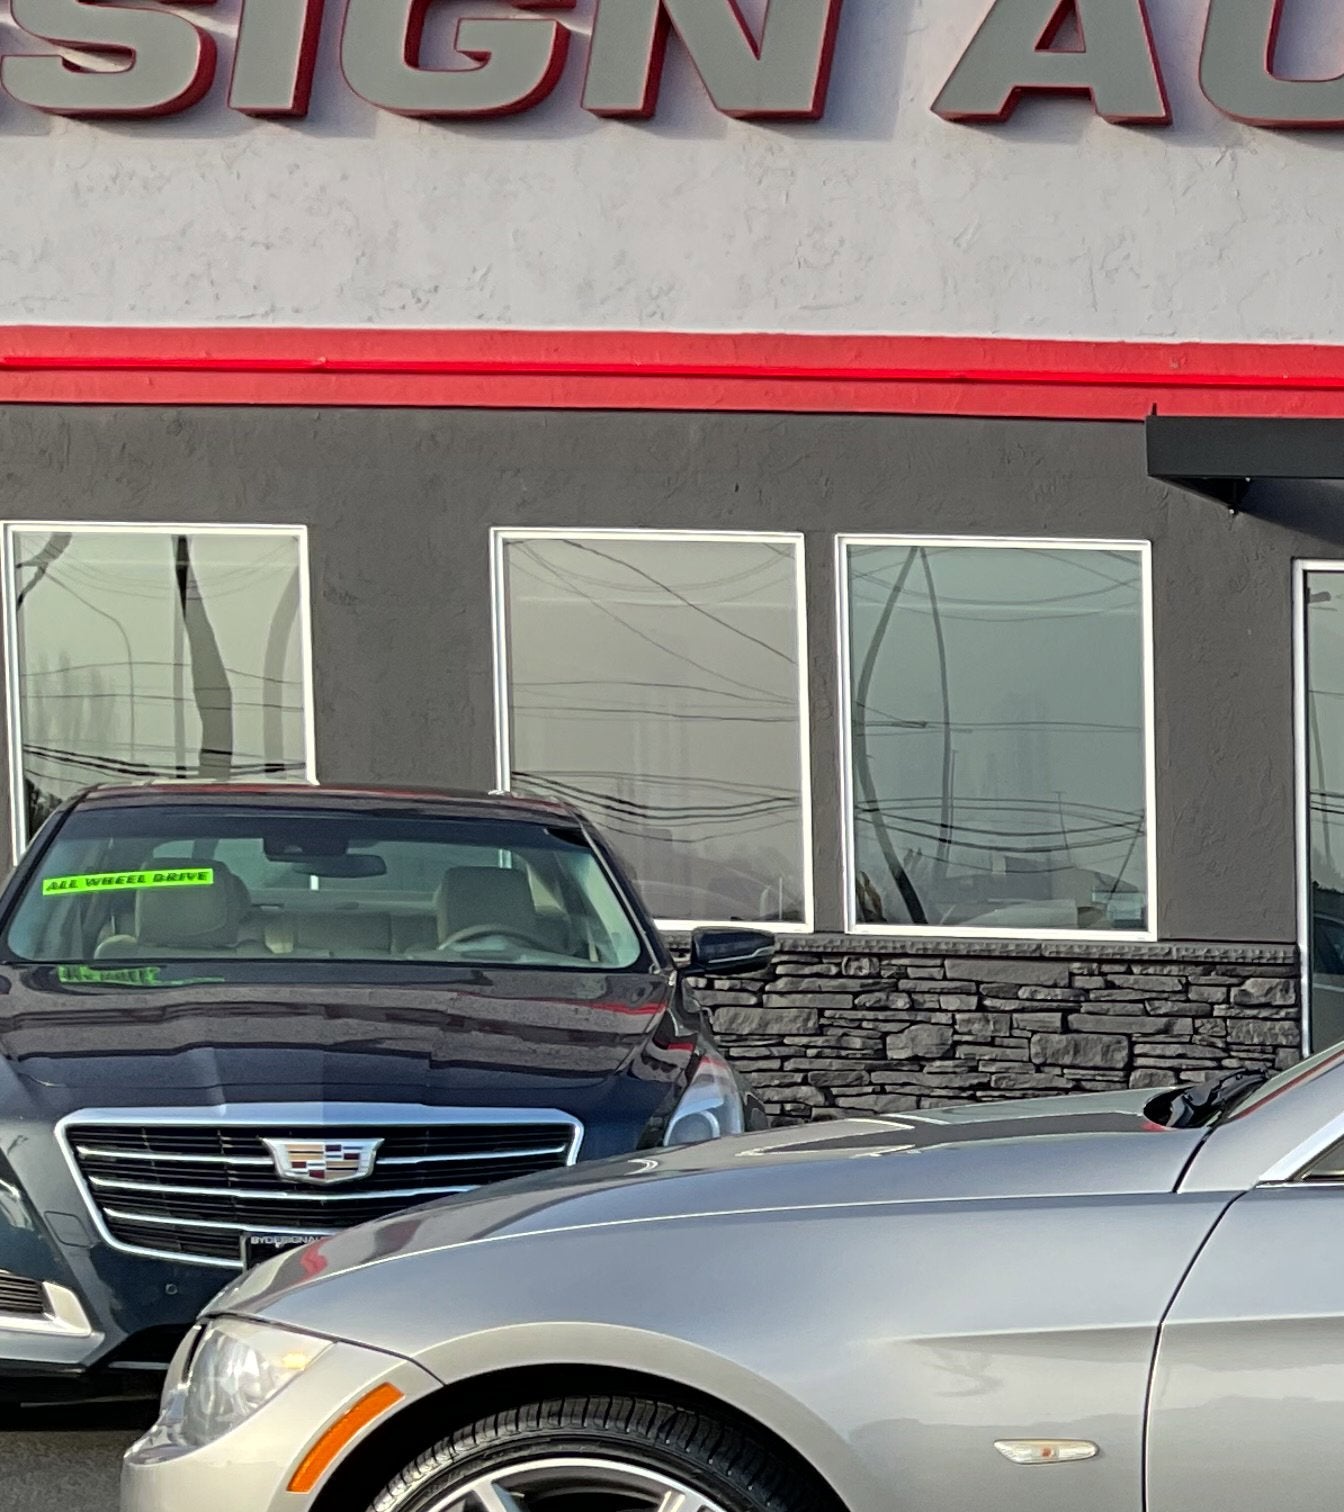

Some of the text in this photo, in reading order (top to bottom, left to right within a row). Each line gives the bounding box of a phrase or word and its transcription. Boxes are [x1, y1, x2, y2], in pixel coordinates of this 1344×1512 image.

[46, 871, 209, 891] ALL WHEEL DRIVE
